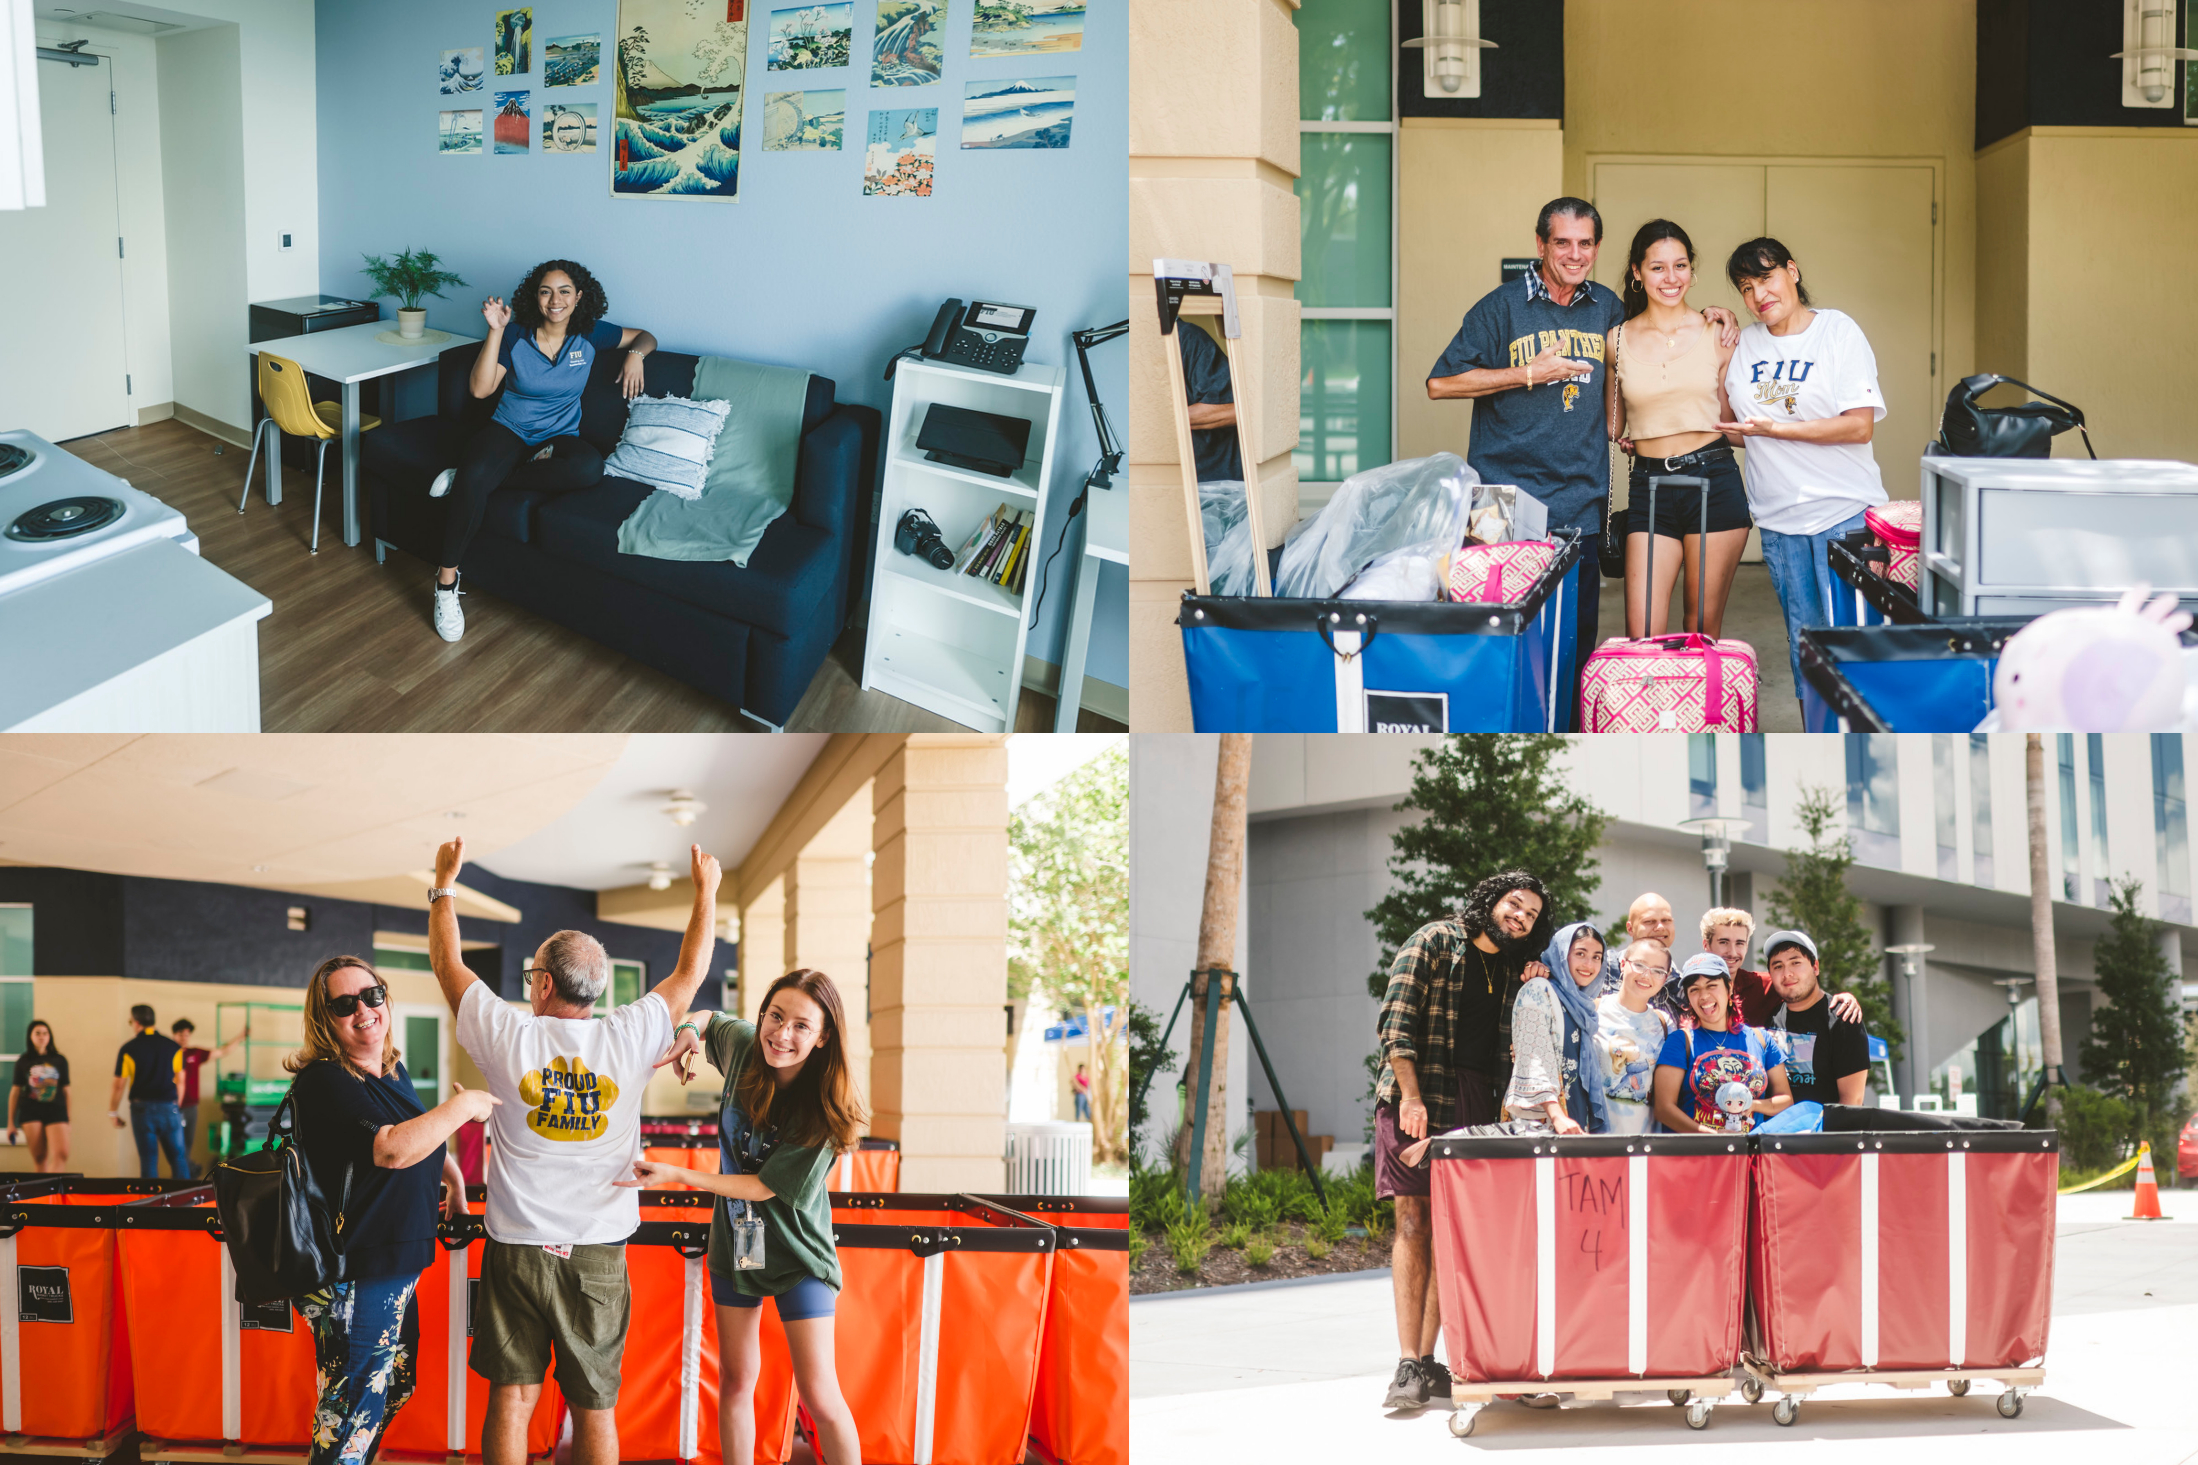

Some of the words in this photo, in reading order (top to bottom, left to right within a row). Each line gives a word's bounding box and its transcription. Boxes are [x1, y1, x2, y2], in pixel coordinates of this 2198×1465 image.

[570, 350, 582, 359] FIU
[1508, 333, 1536, 367] FIU
[1750, 359, 1814, 383] FIU
[1754, 379, 1800, 400] Mom
[1376, 721, 1431, 733] ROYAL
[541, 1067, 597, 1091] PROUD
[539, 1087, 601, 1115] FIU
[536, 1111, 601, 1130] FAMILY
[1558, 1172, 1625, 1229] TAM
[1580, 1228, 1603, 1272] 4
[28, 1284, 64, 1300] ROYAL
